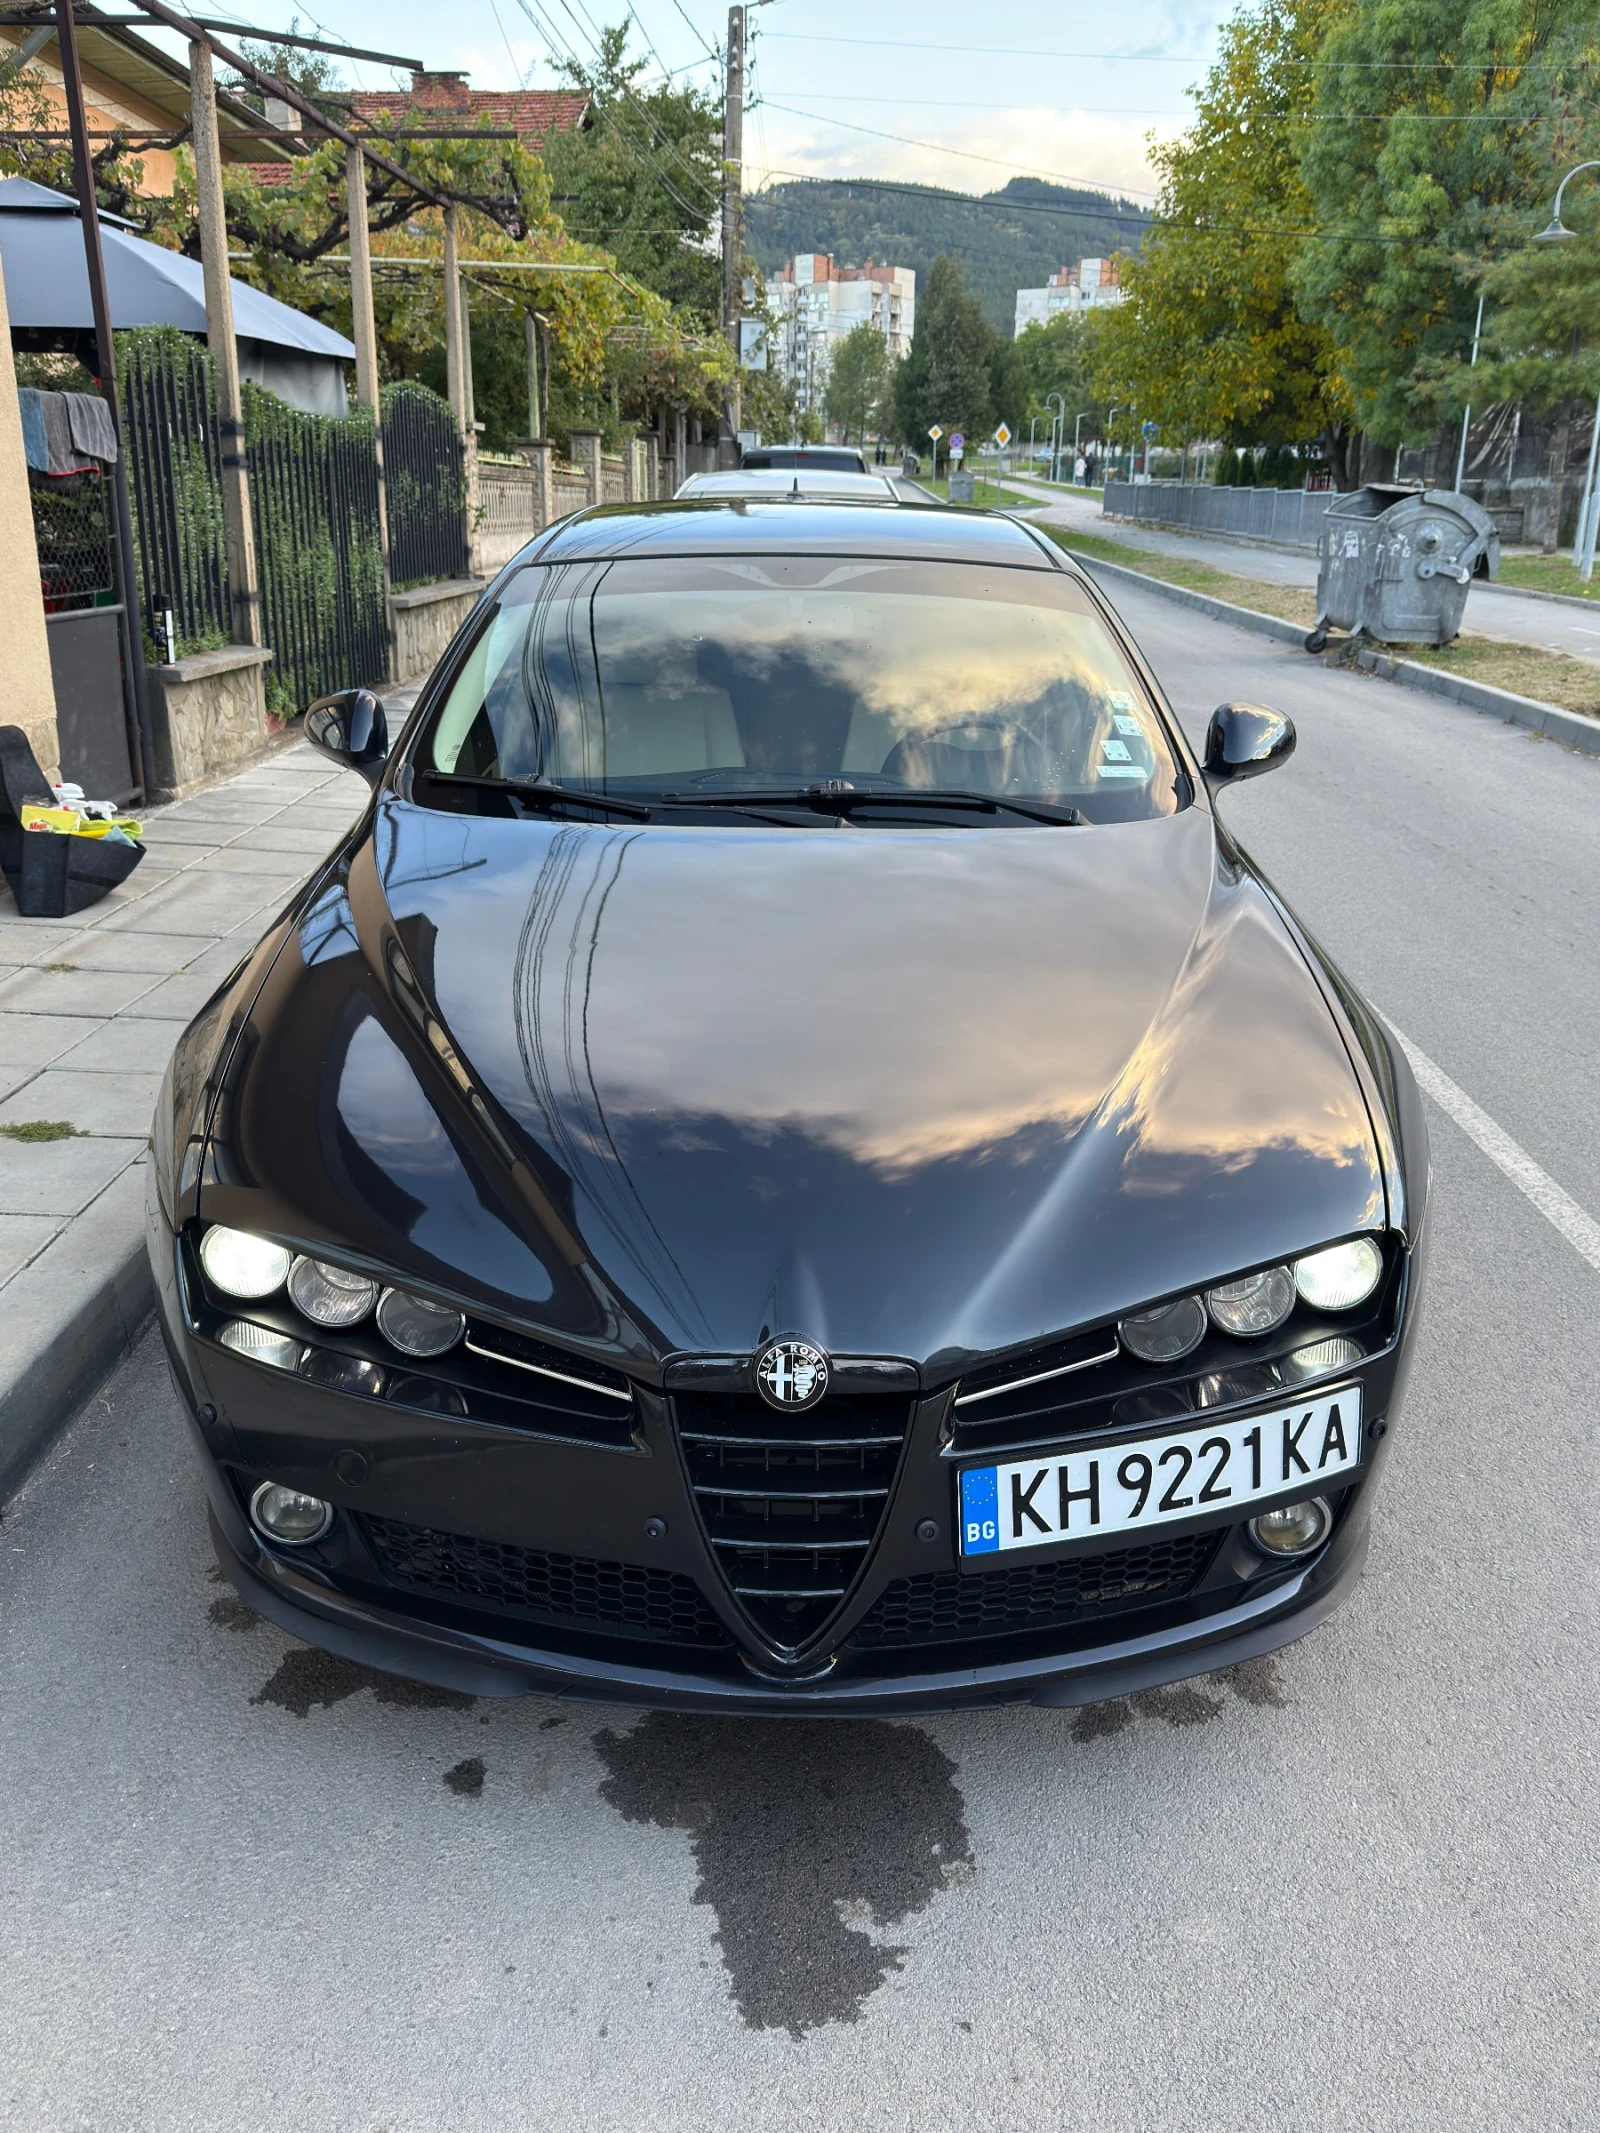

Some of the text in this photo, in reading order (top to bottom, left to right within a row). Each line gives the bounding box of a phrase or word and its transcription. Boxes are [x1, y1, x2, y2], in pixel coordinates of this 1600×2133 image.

[759, 1345, 826, 1380] ALFA ROMEO
[1012, 1404, 1347, 1537] KH 9221 KA
[967, 1521, 995, 1542] BG
